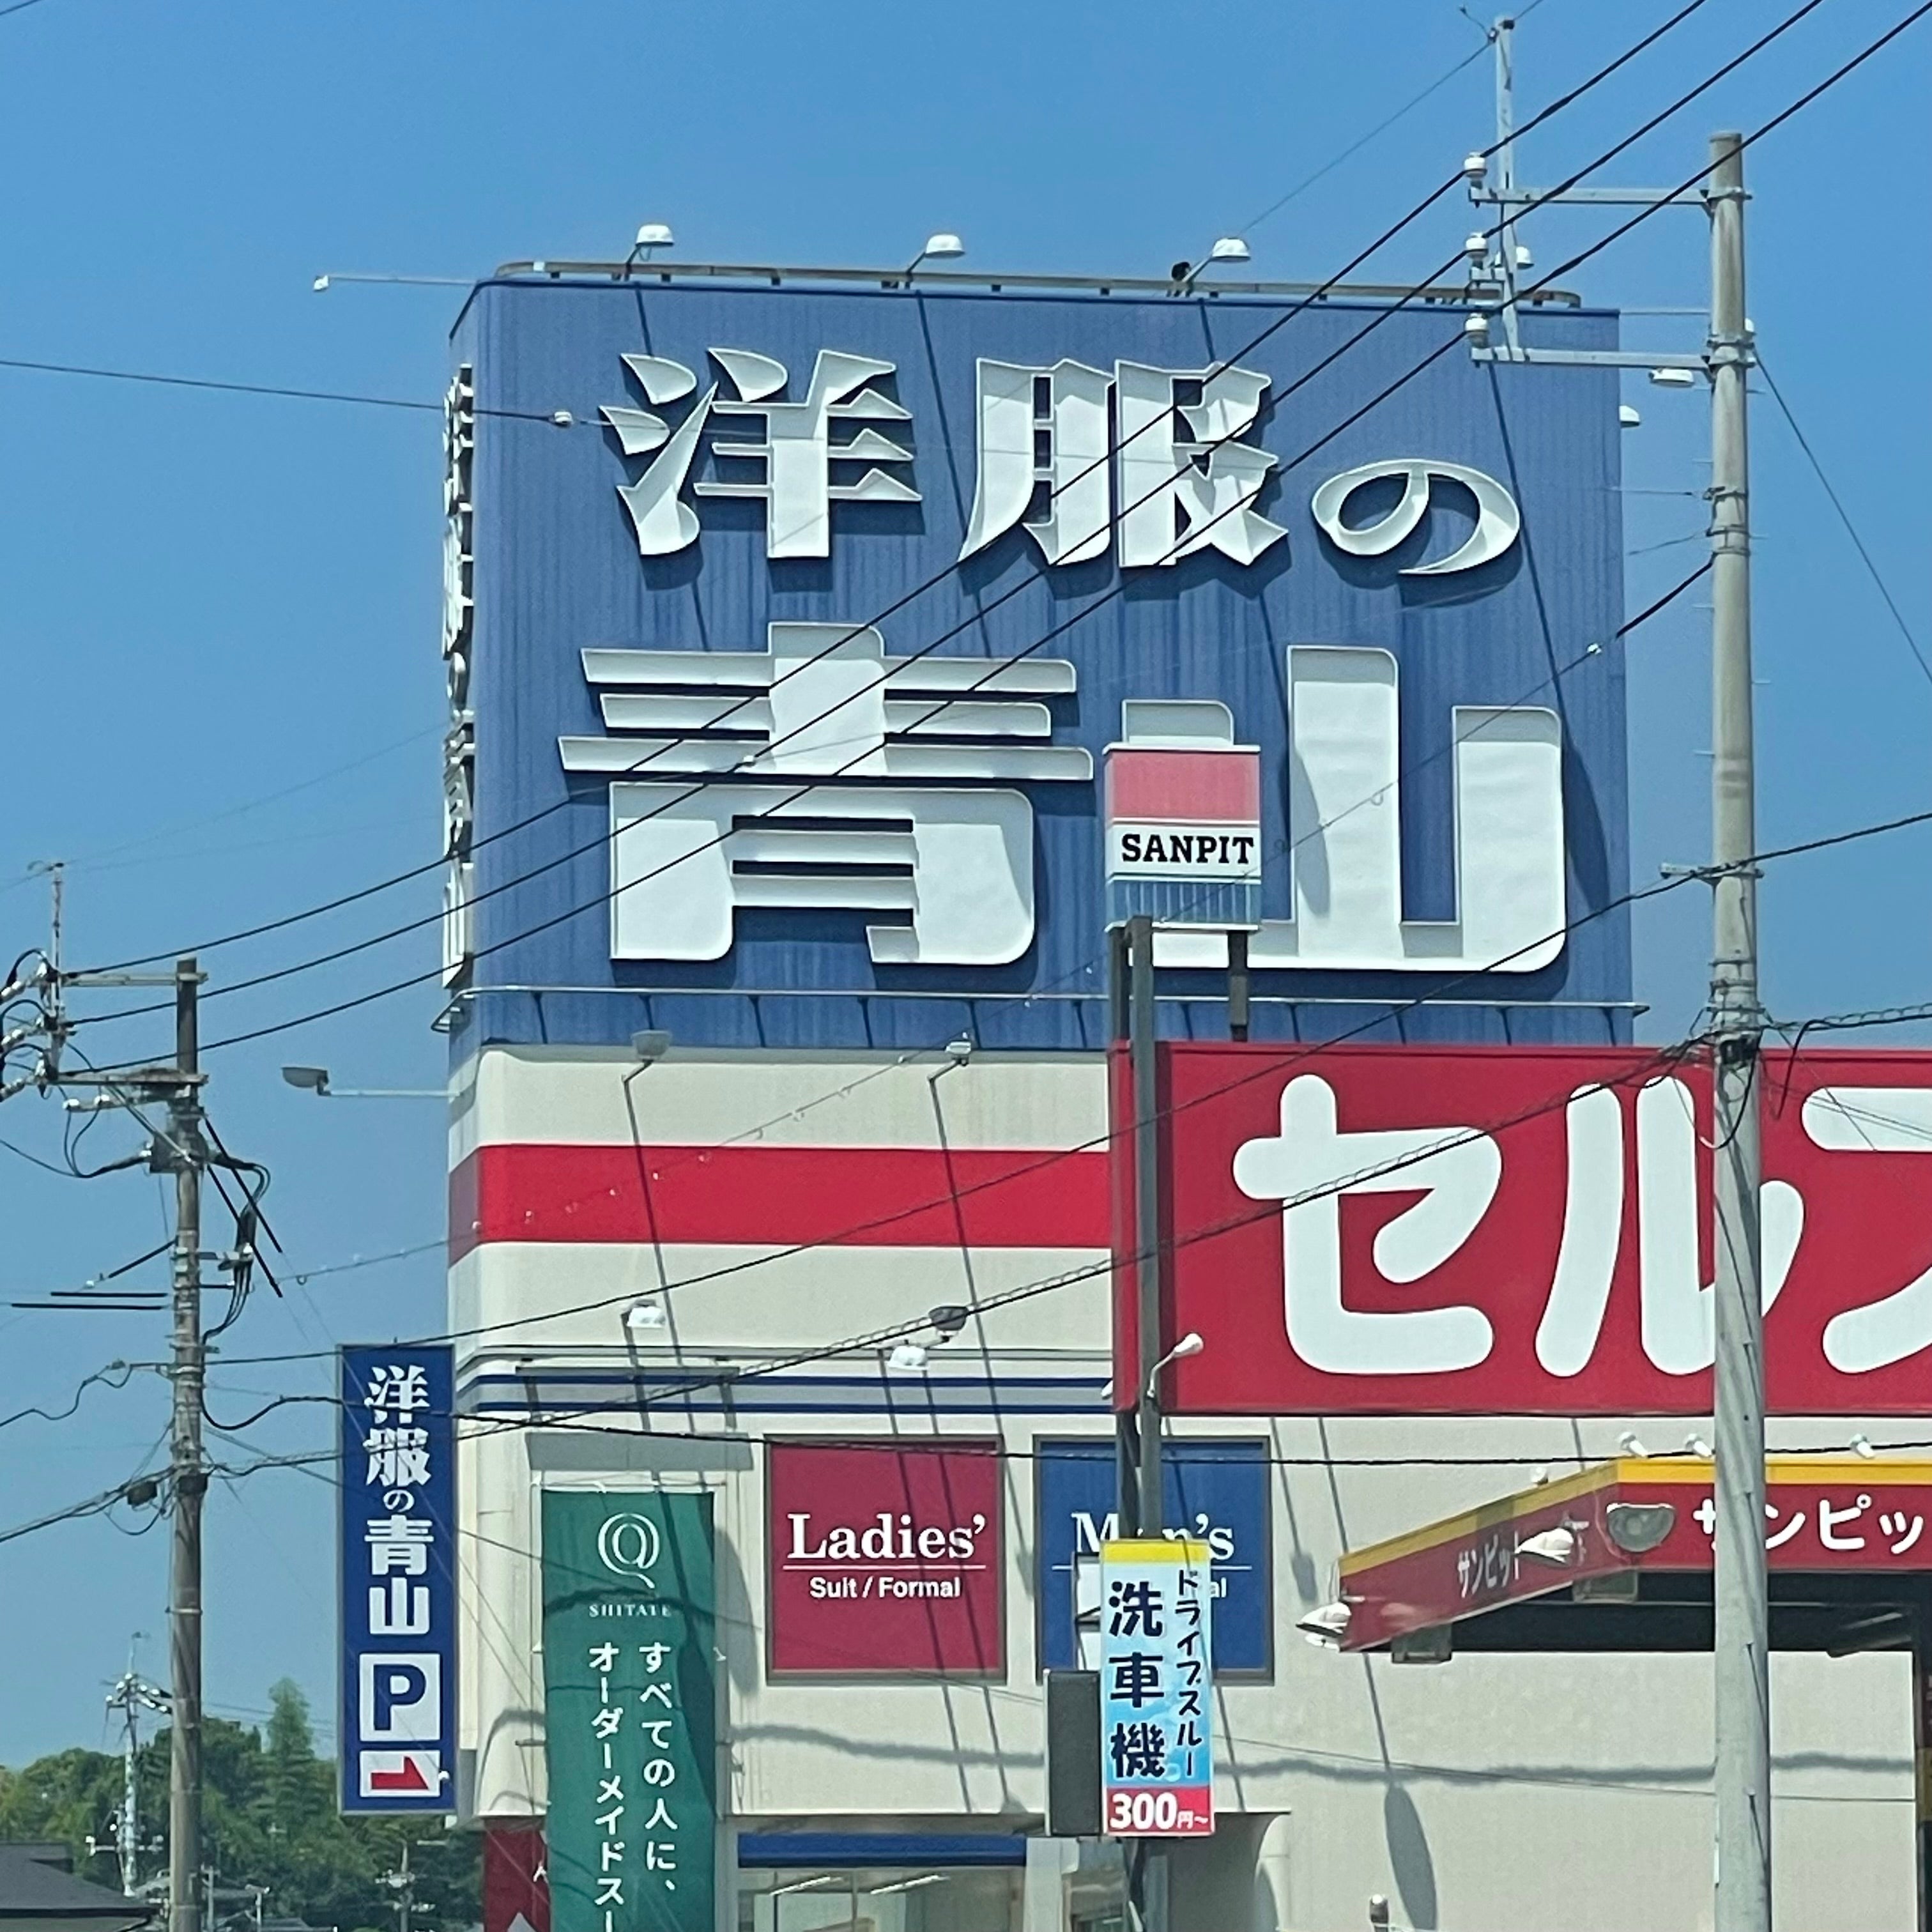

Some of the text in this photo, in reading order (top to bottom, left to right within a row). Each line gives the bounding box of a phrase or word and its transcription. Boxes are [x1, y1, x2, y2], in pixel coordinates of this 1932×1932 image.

[597, 347, 1521, 575] 洋服の
[558, 621, 1567, 972] 青山
[1121, 833, 1254, 864] SANPIT
[363, 1365, 434, 1634] 洋服の青山
[786, 1513, 986, 1559] Ladies'
[809, 1576, 858, 1598] Suit
[878, 1576, 962, 1598] Formal
[373, 1664, 427, 1731] P
[639, 1641, 678, 1890] すべての人に、
[1108, 1581, 1165, 1778] 洗車機
[588, 1641, 625, 1932] オーダーメイドスー
